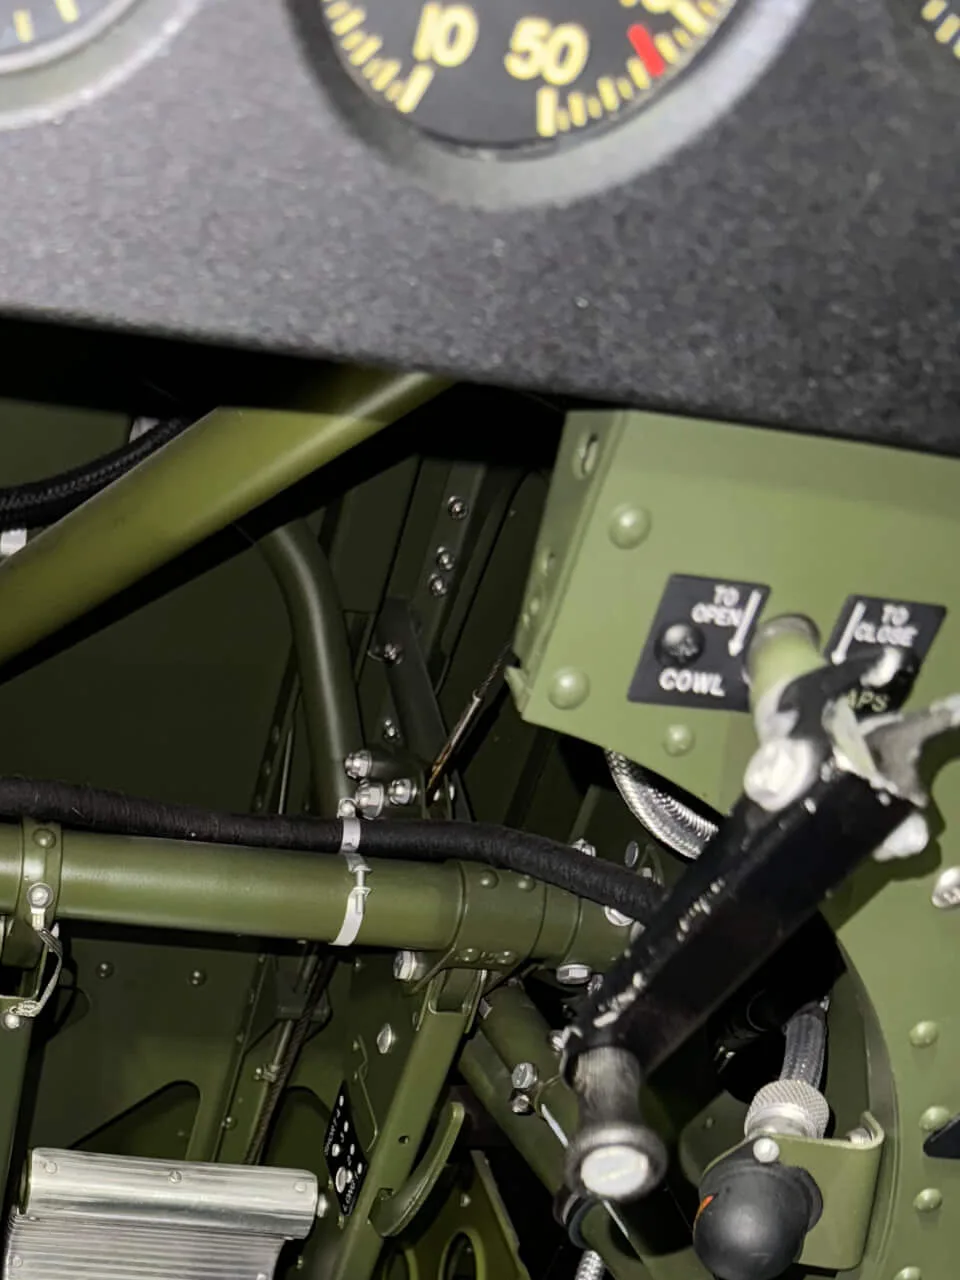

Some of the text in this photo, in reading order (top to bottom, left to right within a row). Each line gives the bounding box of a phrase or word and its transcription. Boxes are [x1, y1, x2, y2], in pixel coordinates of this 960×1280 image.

[413, 2, 478, 66] 10
[504, 17, 589, 85] 50
[714, 584, 740, 607] TO
[691, 603, 743, 627] OPEN
[881, 604, 910, 626] TO
[853, 620, 918, 647] CLOSE
[658, 668, 725, 697] COWL
